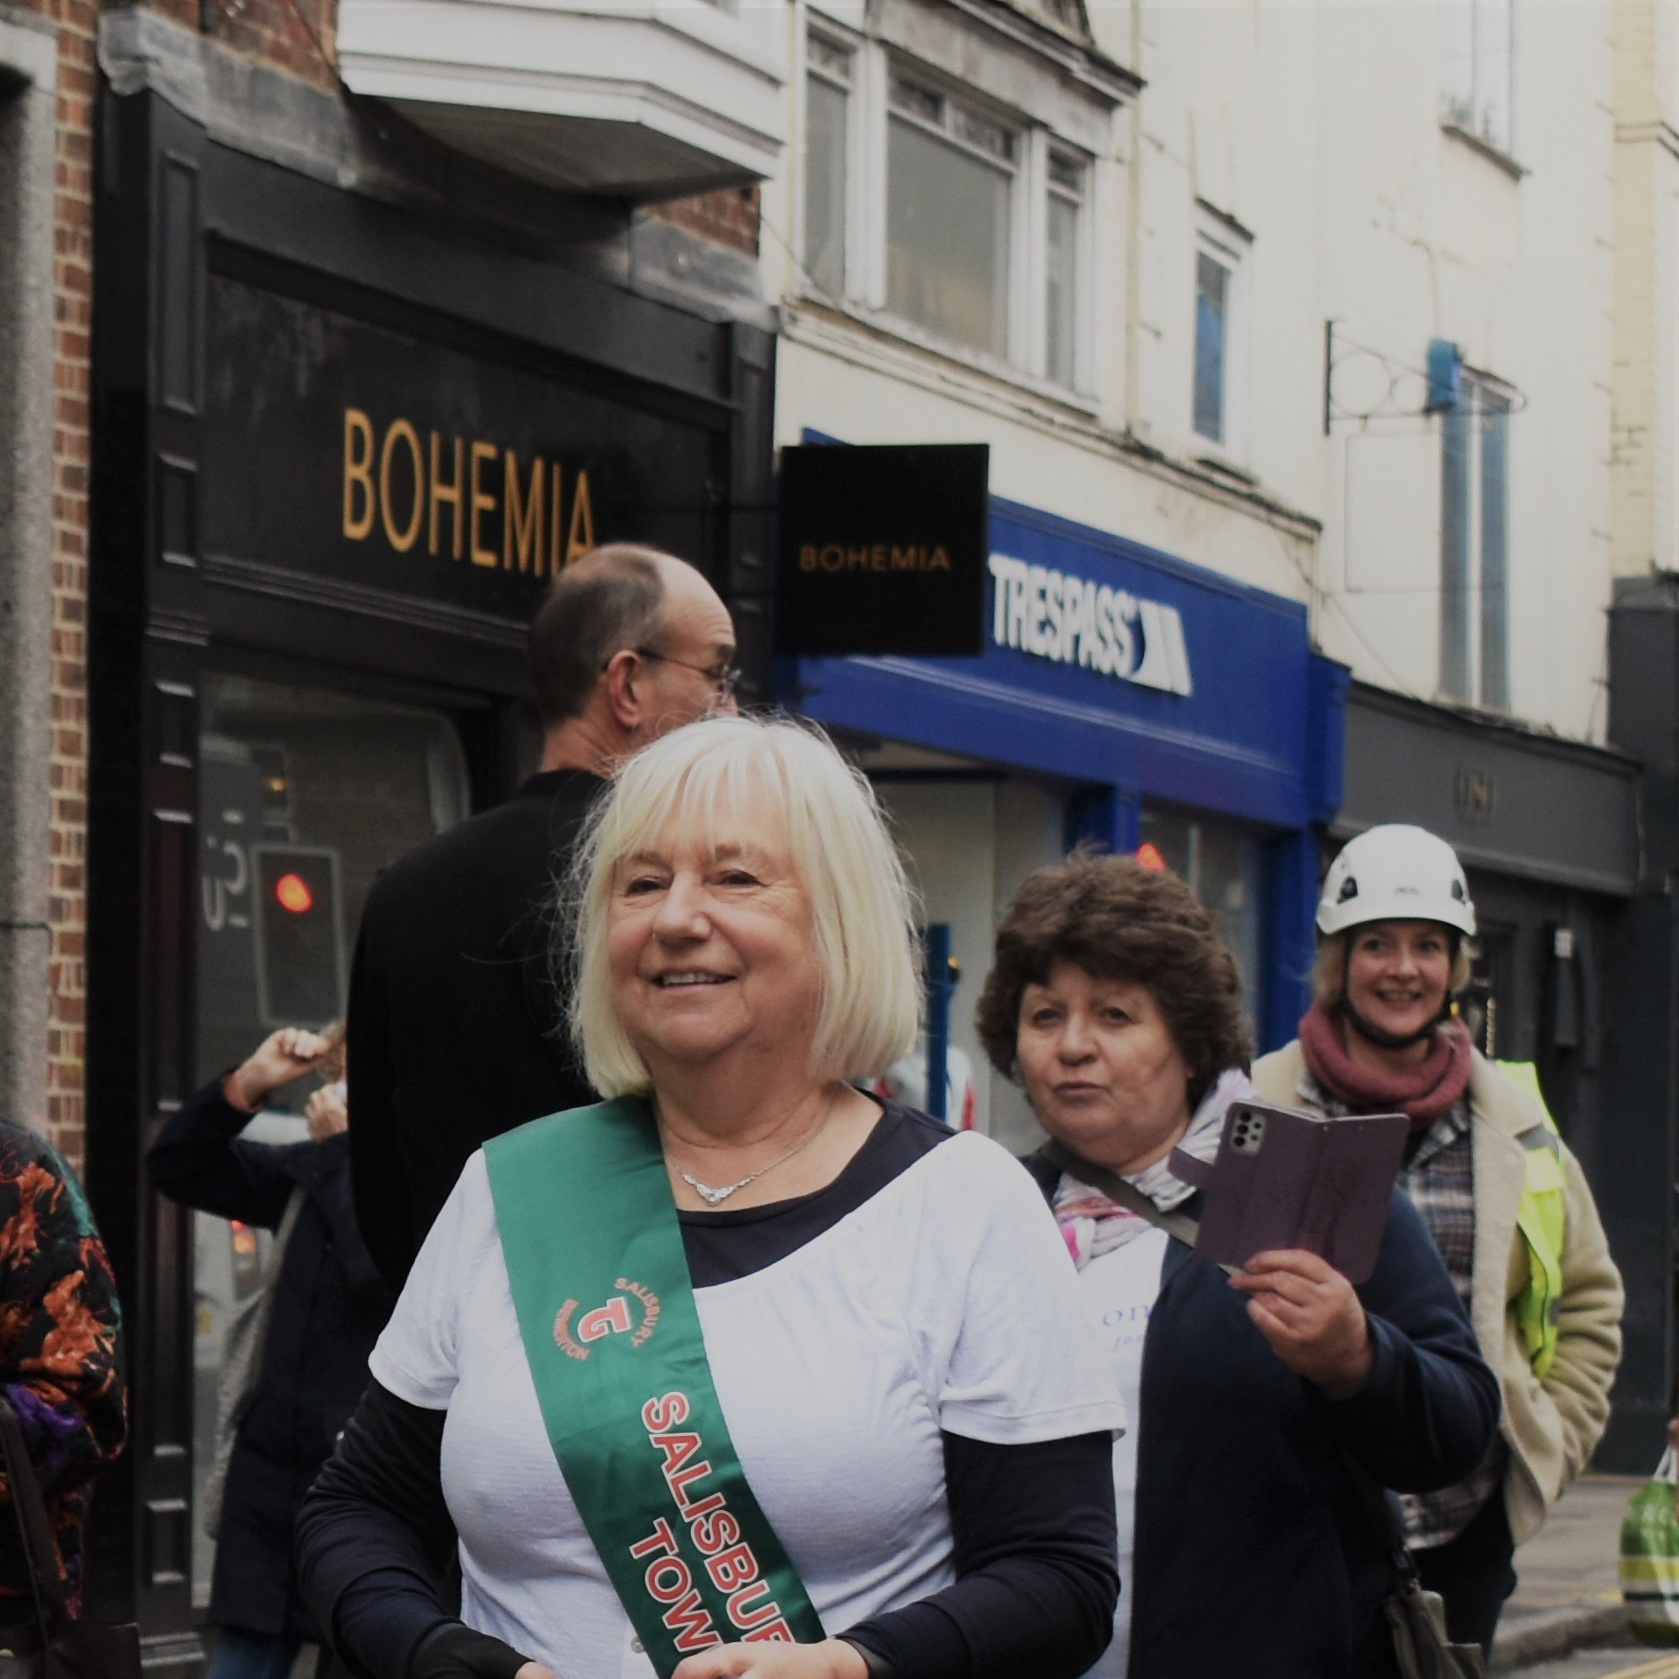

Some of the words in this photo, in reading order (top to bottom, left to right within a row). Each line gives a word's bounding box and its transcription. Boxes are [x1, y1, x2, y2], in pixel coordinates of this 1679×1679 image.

[343, 407, 595, 578] BOHEMIA
[799, 544, 952, 573] BOHEMIA
[987, 553, 1142, 678] TRESPASS
